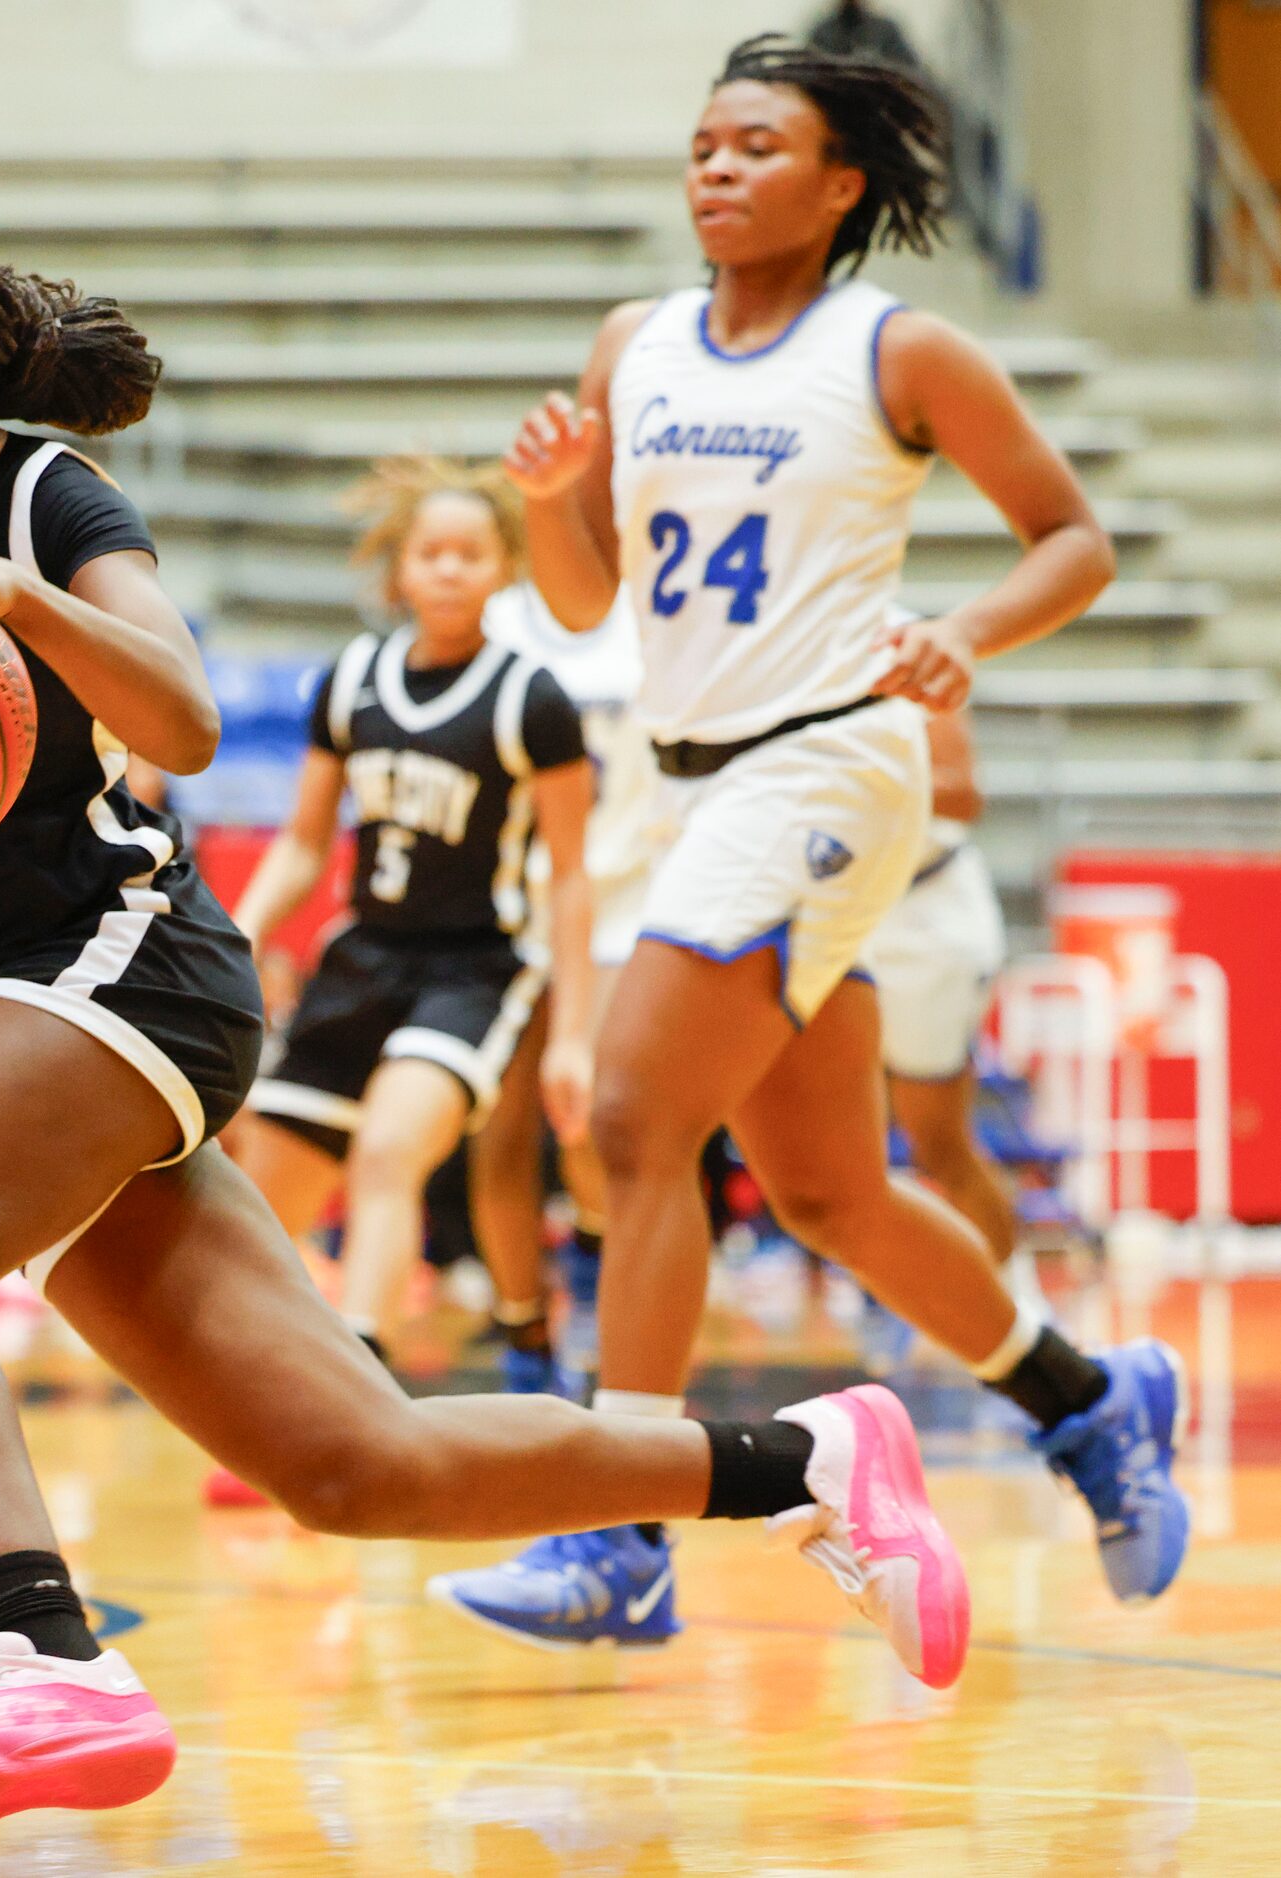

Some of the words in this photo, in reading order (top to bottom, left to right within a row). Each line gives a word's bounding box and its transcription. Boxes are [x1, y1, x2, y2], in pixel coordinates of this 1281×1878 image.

[632, 396, 803, 484] Conway
[649, 511, 769, 624] 24
[370, 824, 417, 903] 5
